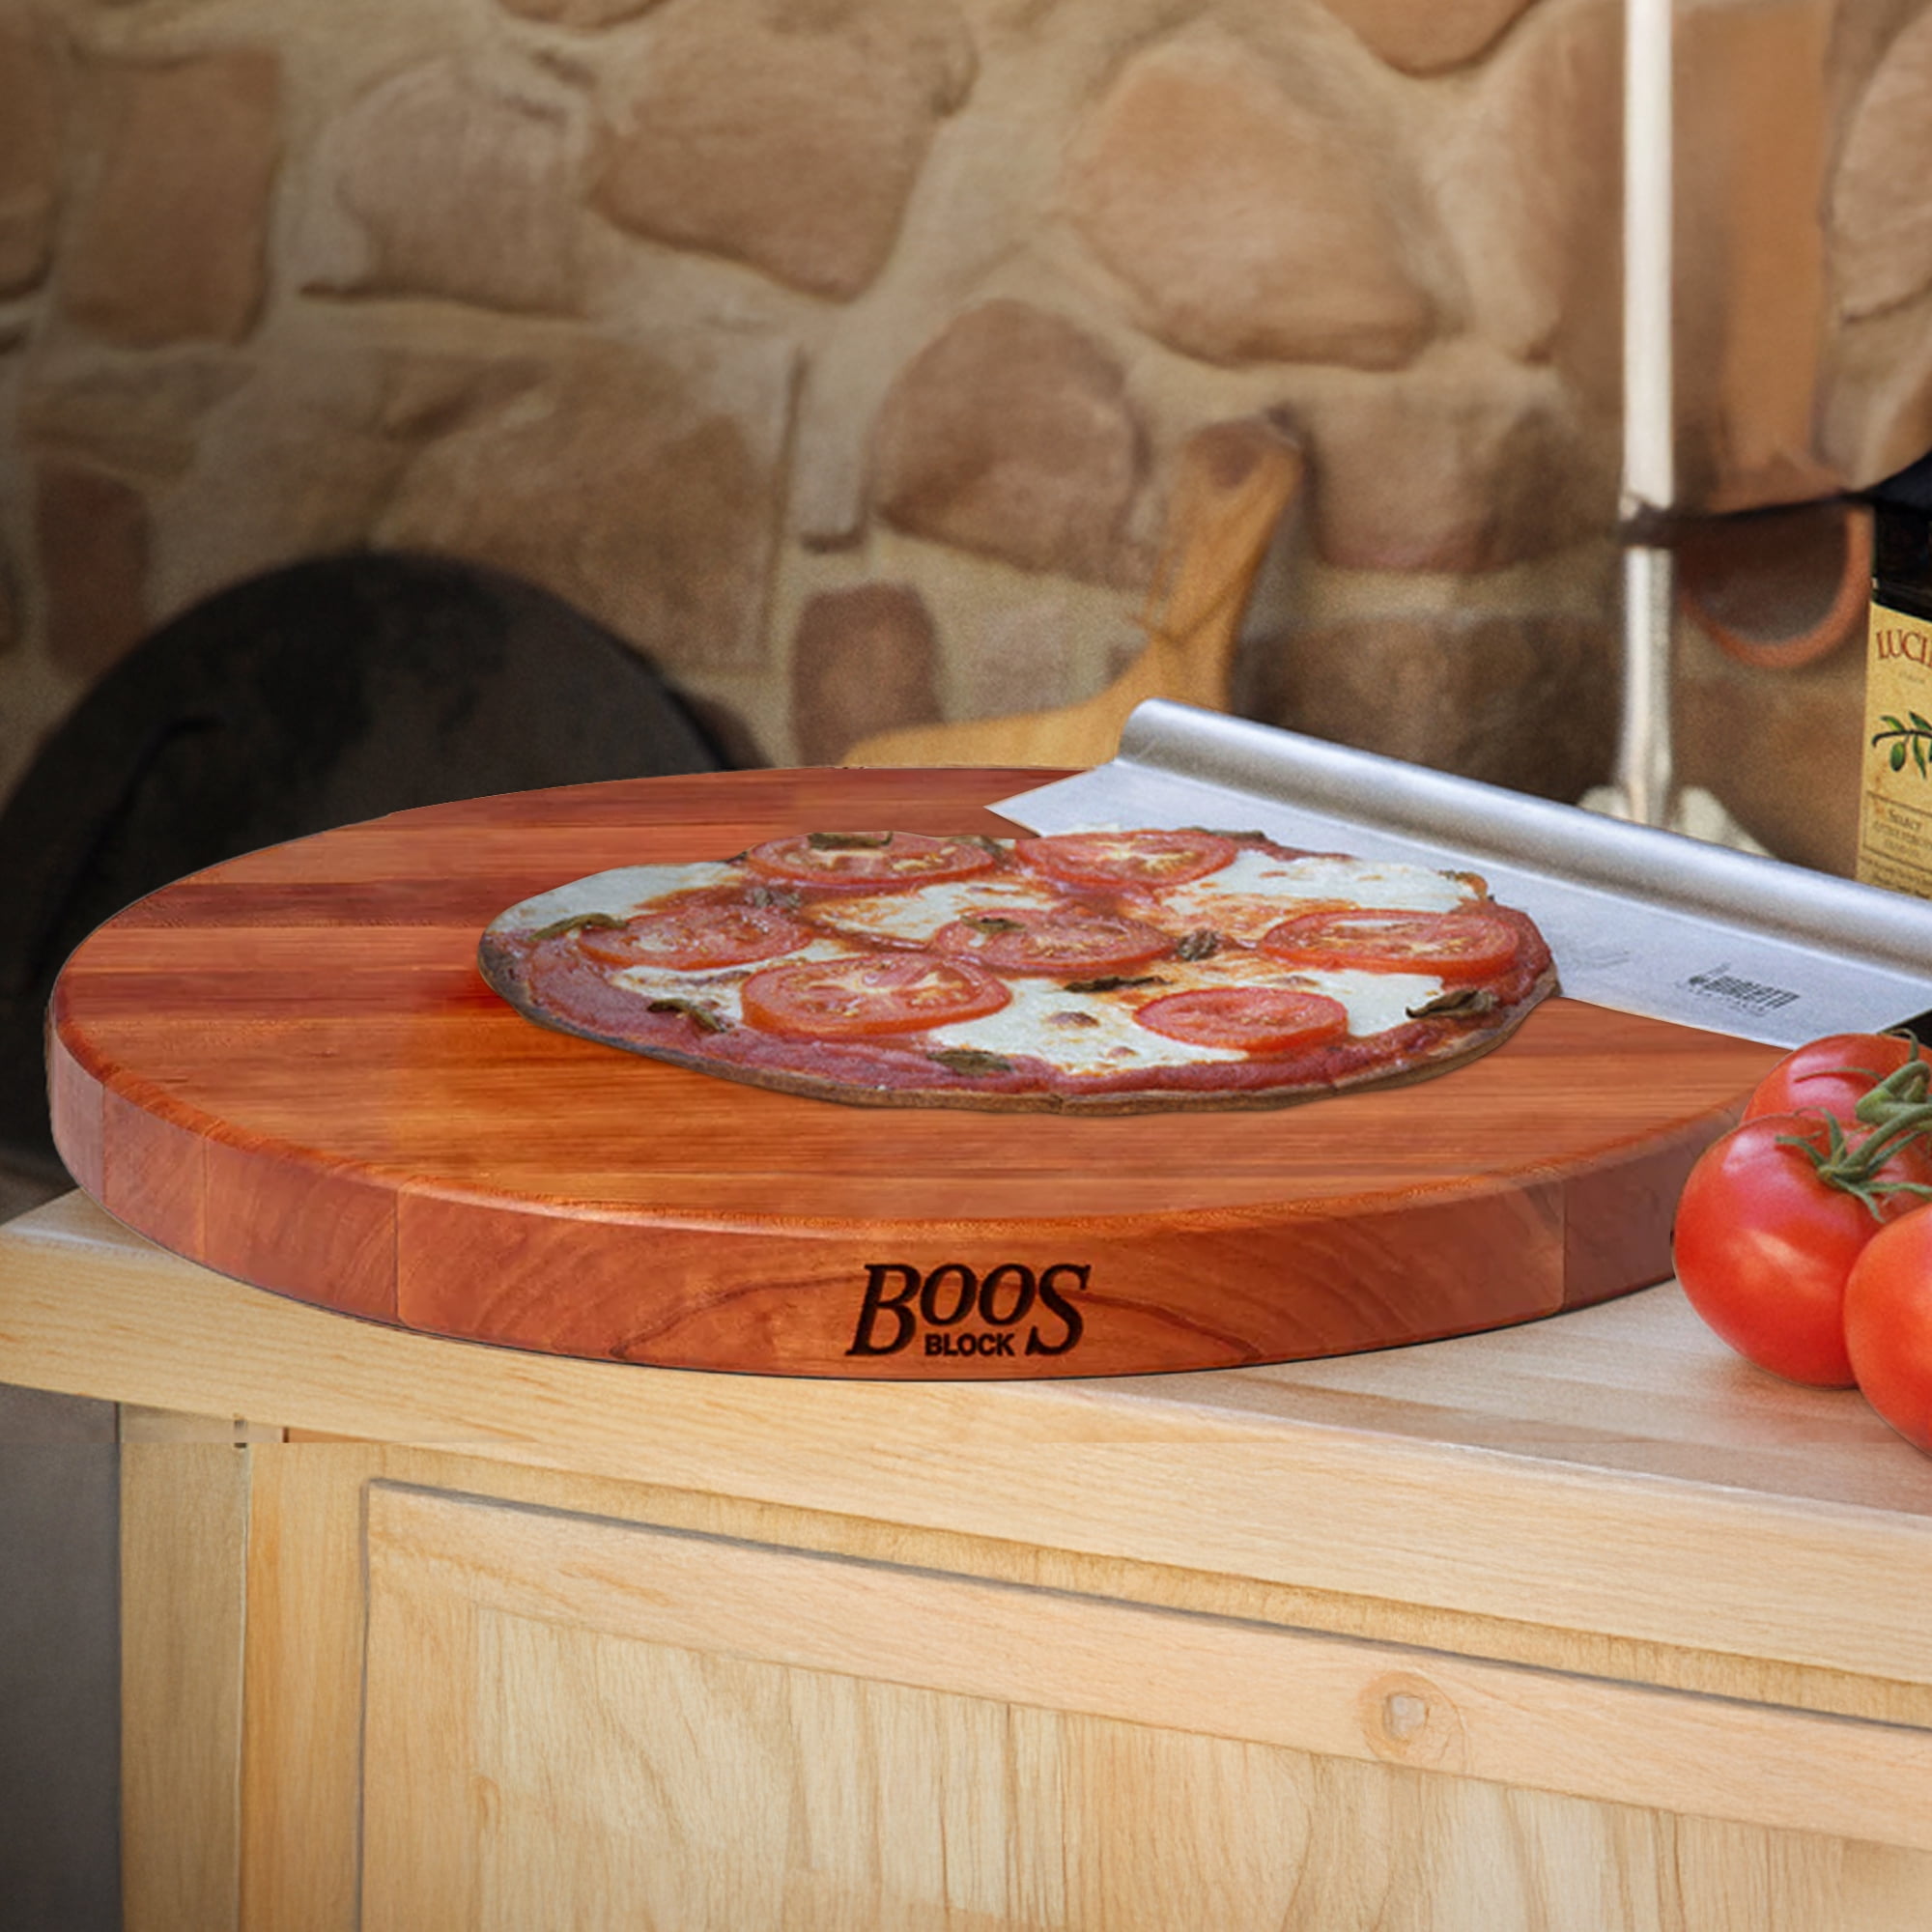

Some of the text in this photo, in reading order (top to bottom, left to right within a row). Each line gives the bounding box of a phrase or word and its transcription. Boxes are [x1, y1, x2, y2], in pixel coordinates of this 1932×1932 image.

[1876, 629, 1932, 668] LUCI
[845, 1264, 1092, 1356] BOOS
[924, 1333, 1015, 1356] BLOCK
